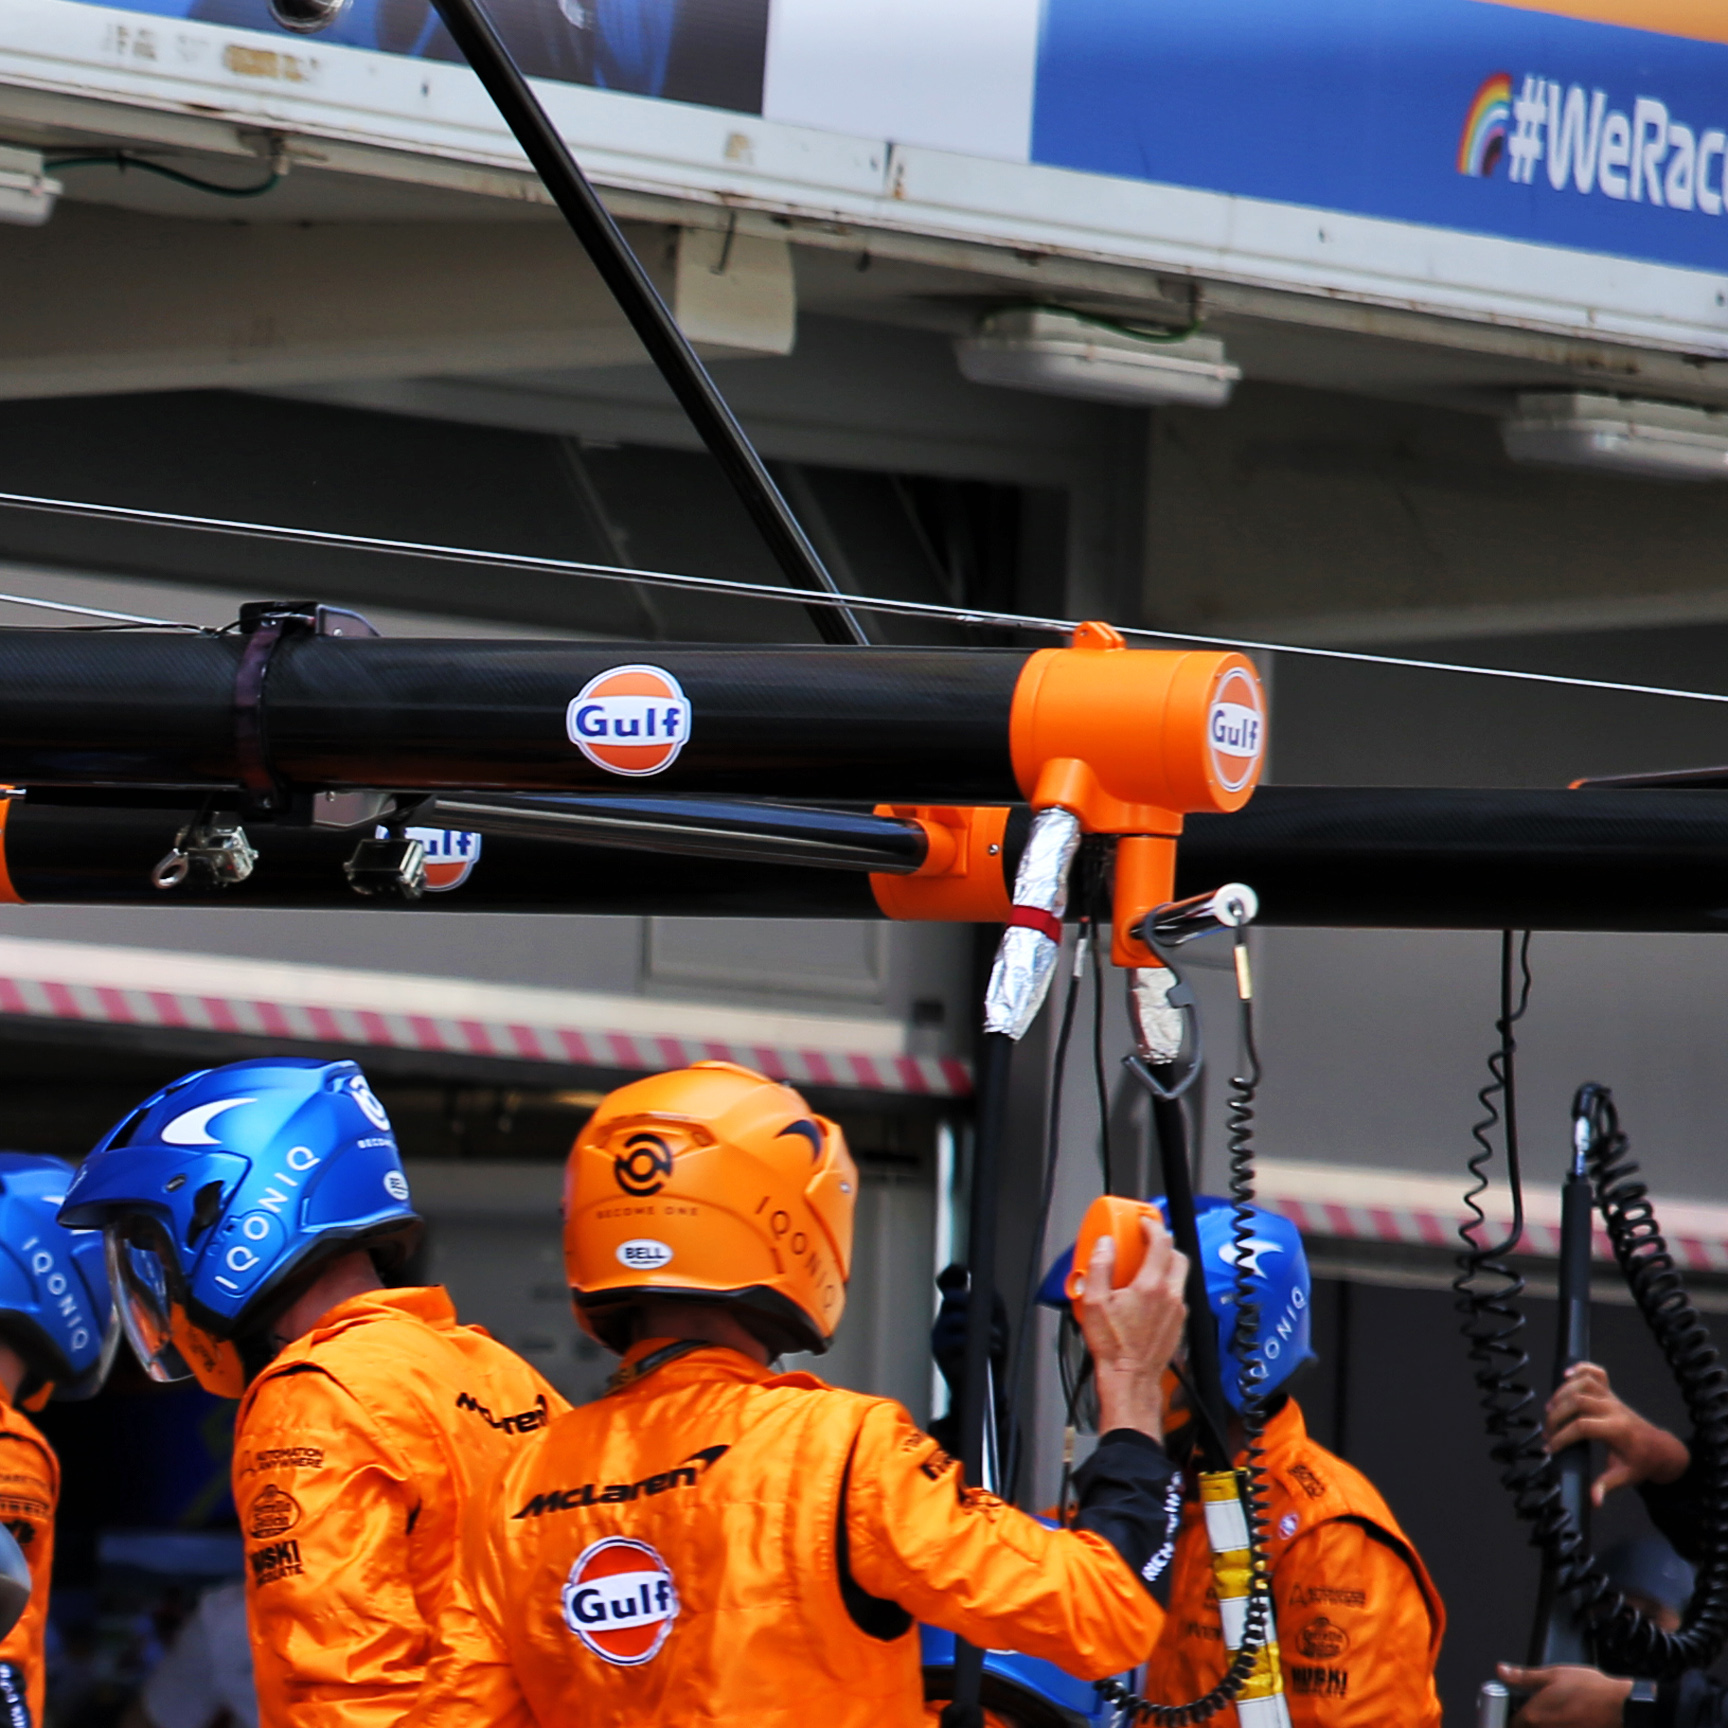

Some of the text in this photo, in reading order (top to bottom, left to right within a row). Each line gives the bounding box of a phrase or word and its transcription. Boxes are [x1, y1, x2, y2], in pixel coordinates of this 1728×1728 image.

[1508, 72, 1728, 216] #WeRac
[575, 703, 683, 738] Gulf
[1210, 708, 1261, 752] Gulf
[214, 1144, 322, 1291] IQONIQ
[624, 1246, 666, 1261] BELL
[1247, 1285, 1307, 1383] QONIQ
[512, 1464, 697, 1520] McLaren
[572, 1580, 671, 1625] Gulf
